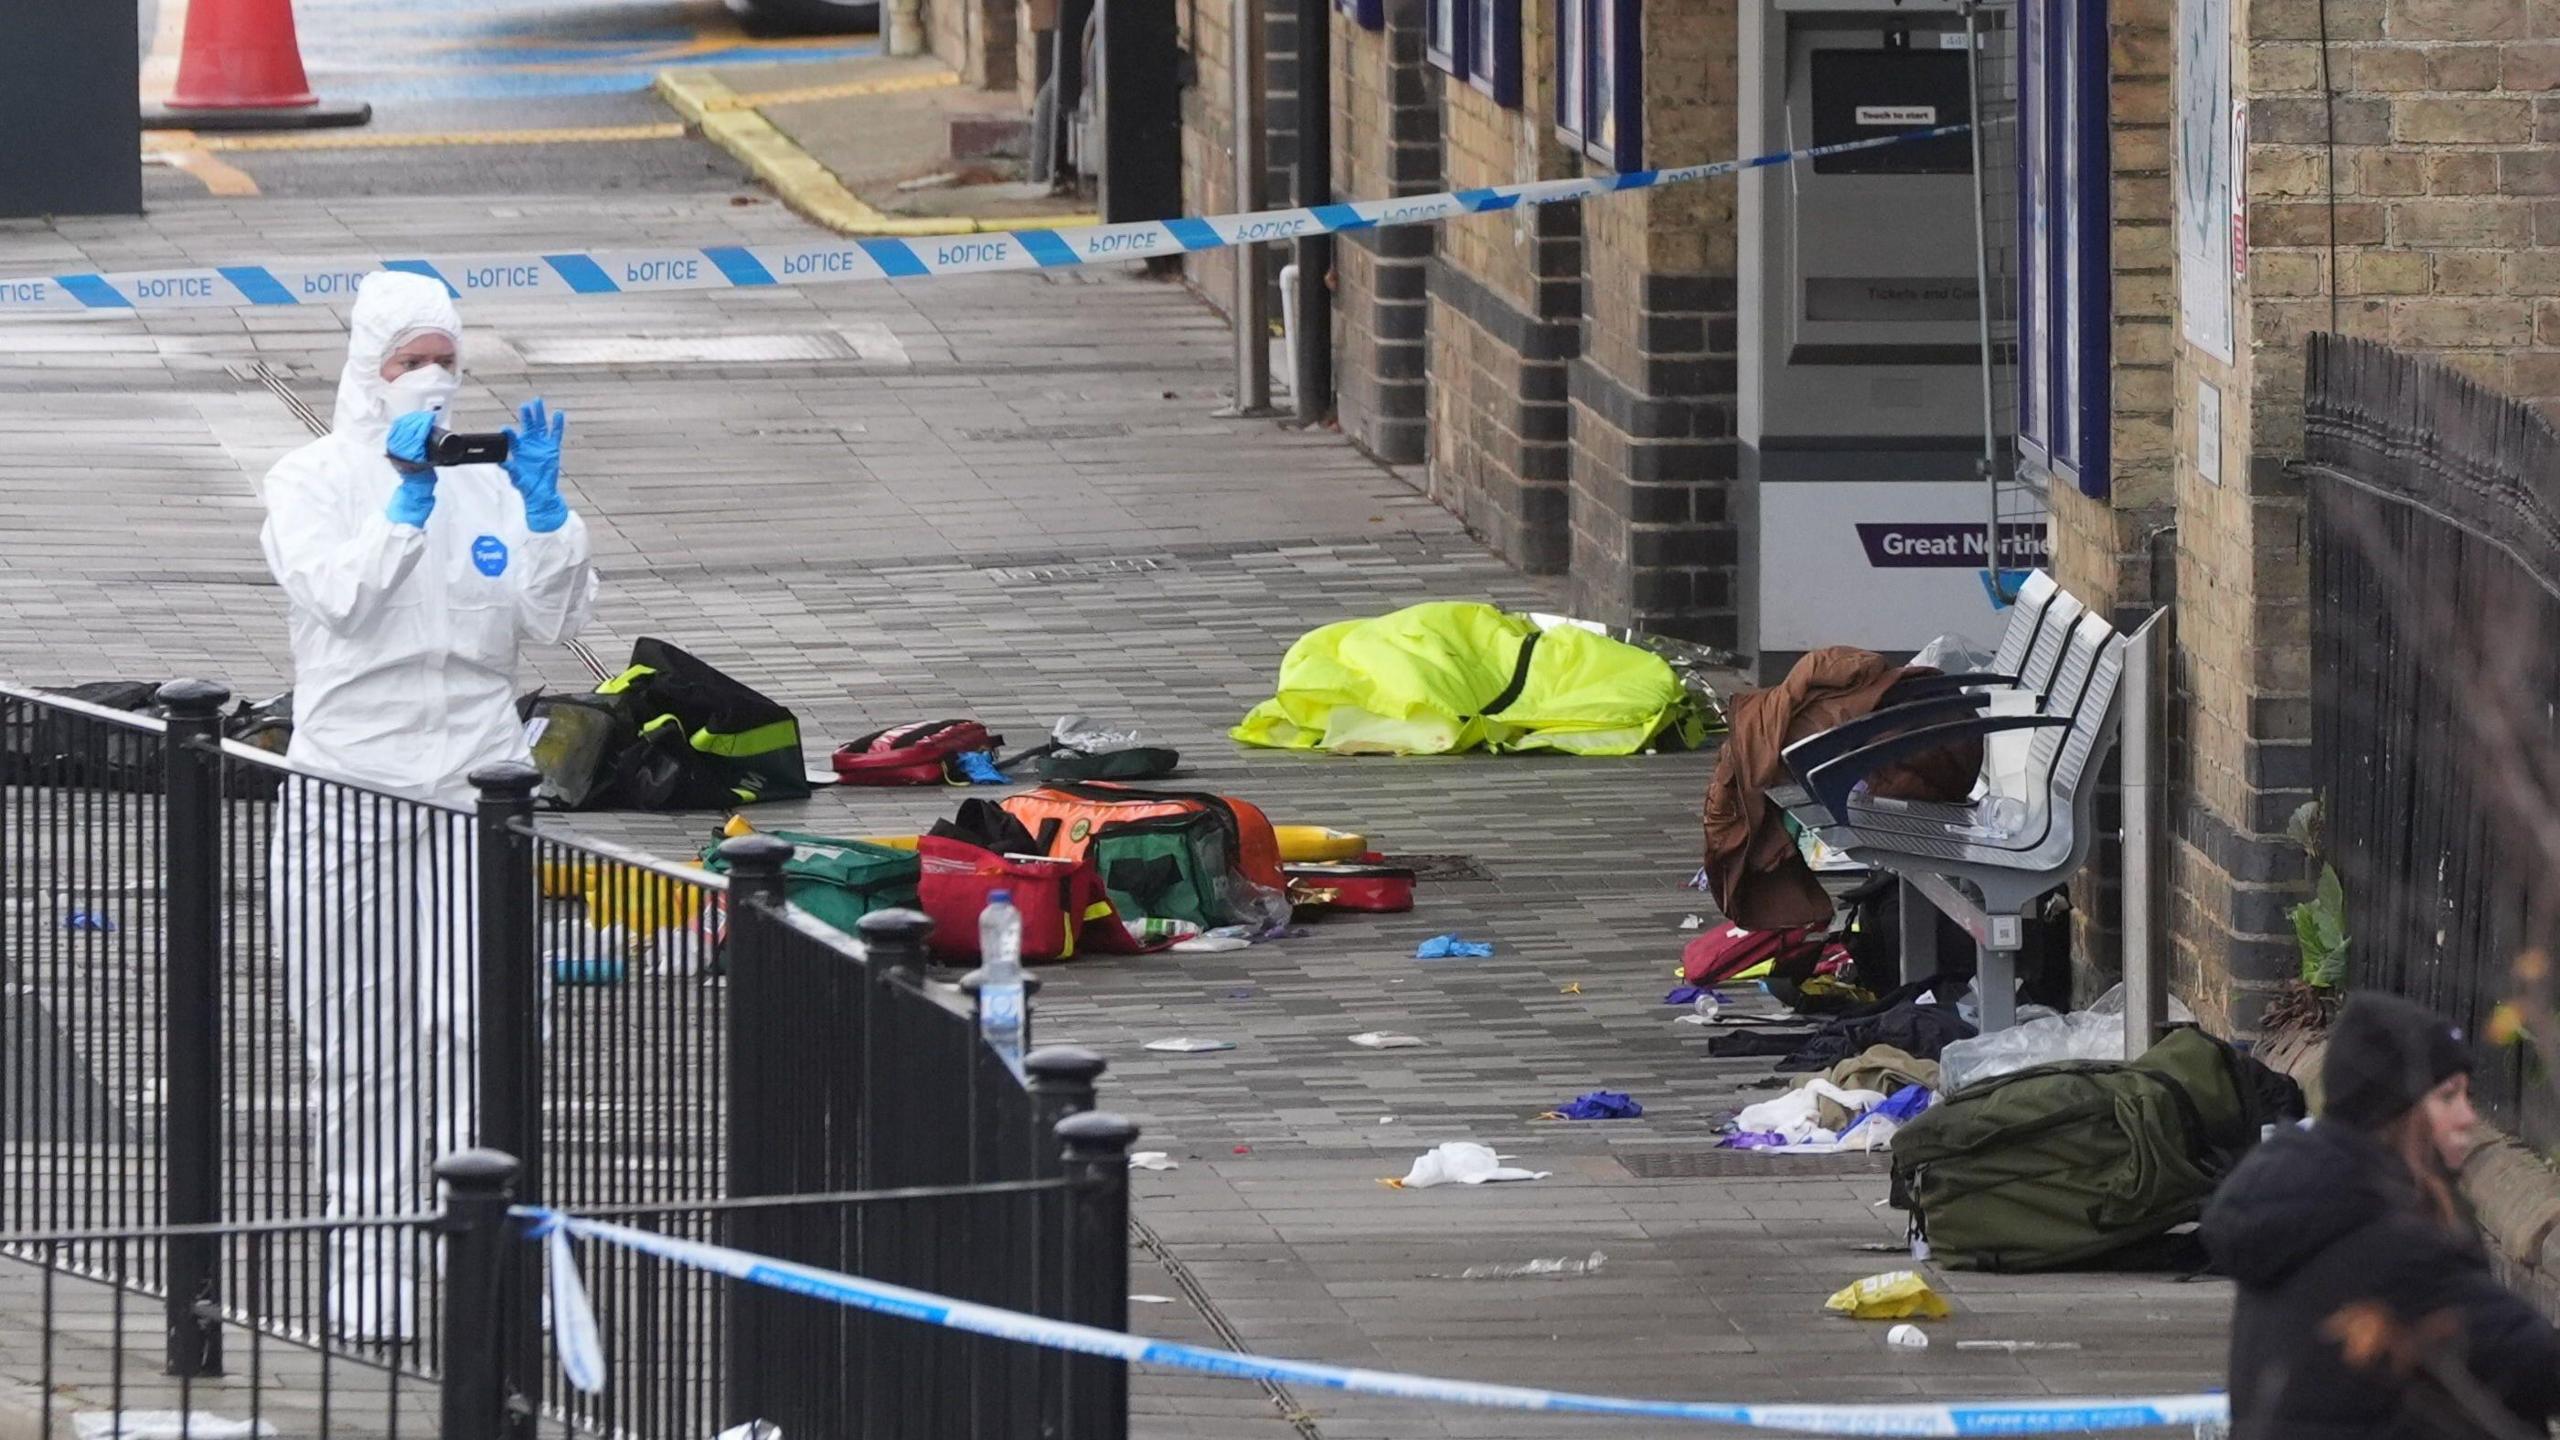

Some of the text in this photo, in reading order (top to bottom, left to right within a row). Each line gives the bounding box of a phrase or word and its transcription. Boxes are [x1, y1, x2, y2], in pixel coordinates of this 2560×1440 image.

[1893, 32, 1901, 46] 1
[1862, 111, 1891, 120] Touch
[1893, 111, 1904, 120] to
[1882, 532, 1958, 555] Great
